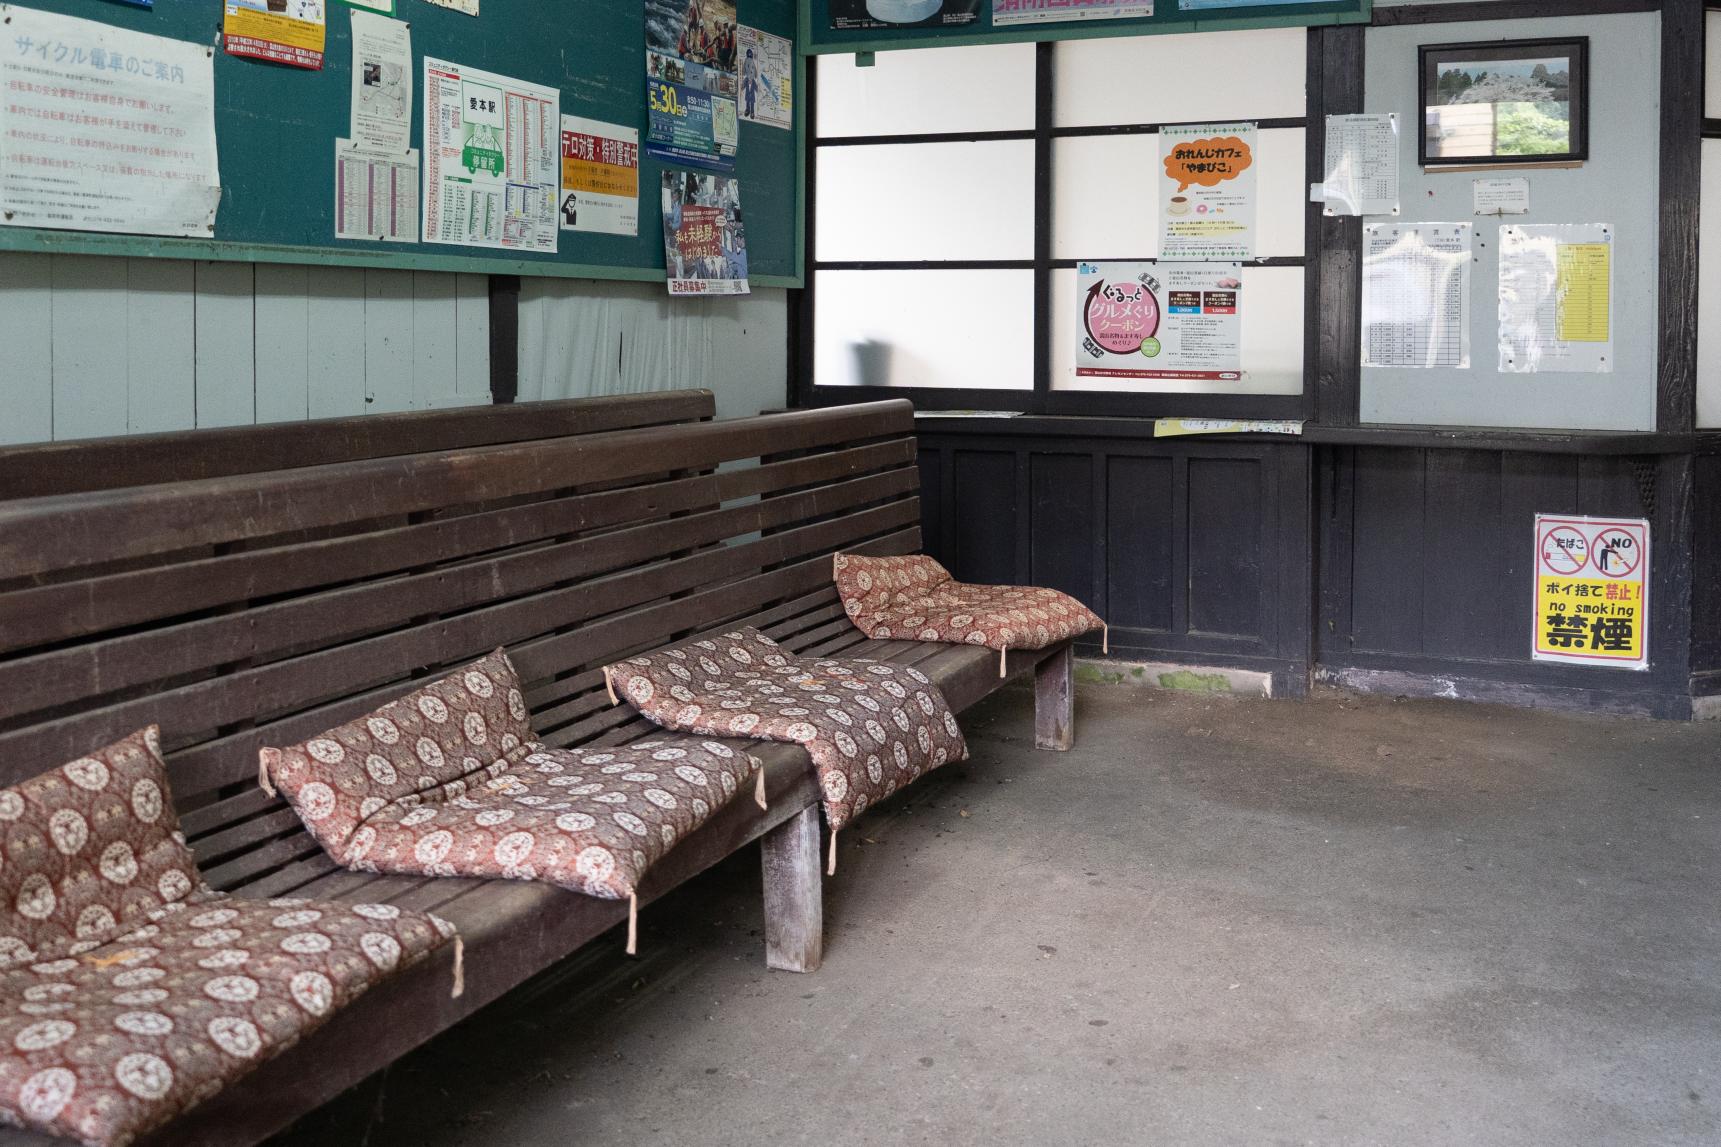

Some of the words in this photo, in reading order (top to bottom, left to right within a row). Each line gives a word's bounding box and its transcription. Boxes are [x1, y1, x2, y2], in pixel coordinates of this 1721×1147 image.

[15, 36, 185, 84] サイクル電車のご案内
[470, 97, 496, 114] 愛本駅
[562, 133, 637, 168] テロ対策・特別警戒中
[1175, 148, 1242, 160] おれんじカフェ
[1181, 162, 1232, 173] 「やまびこ」
[672, 280, 706, 293] 正社員募集中
[1102, 284, 1142, 303] ぐるっと
[1090, 303, 1155, 319] グルメぐり
[1099, 319, 1145, 331] クーポン
[1556, 538, 1585, 550] たばこ
[1611, 538, 1632, 549] NO
[1550, 602, 1566, 612] no
[1575, 603, 1634, 617] smoking
[1546, 613, 1633, 651] 禁煙
